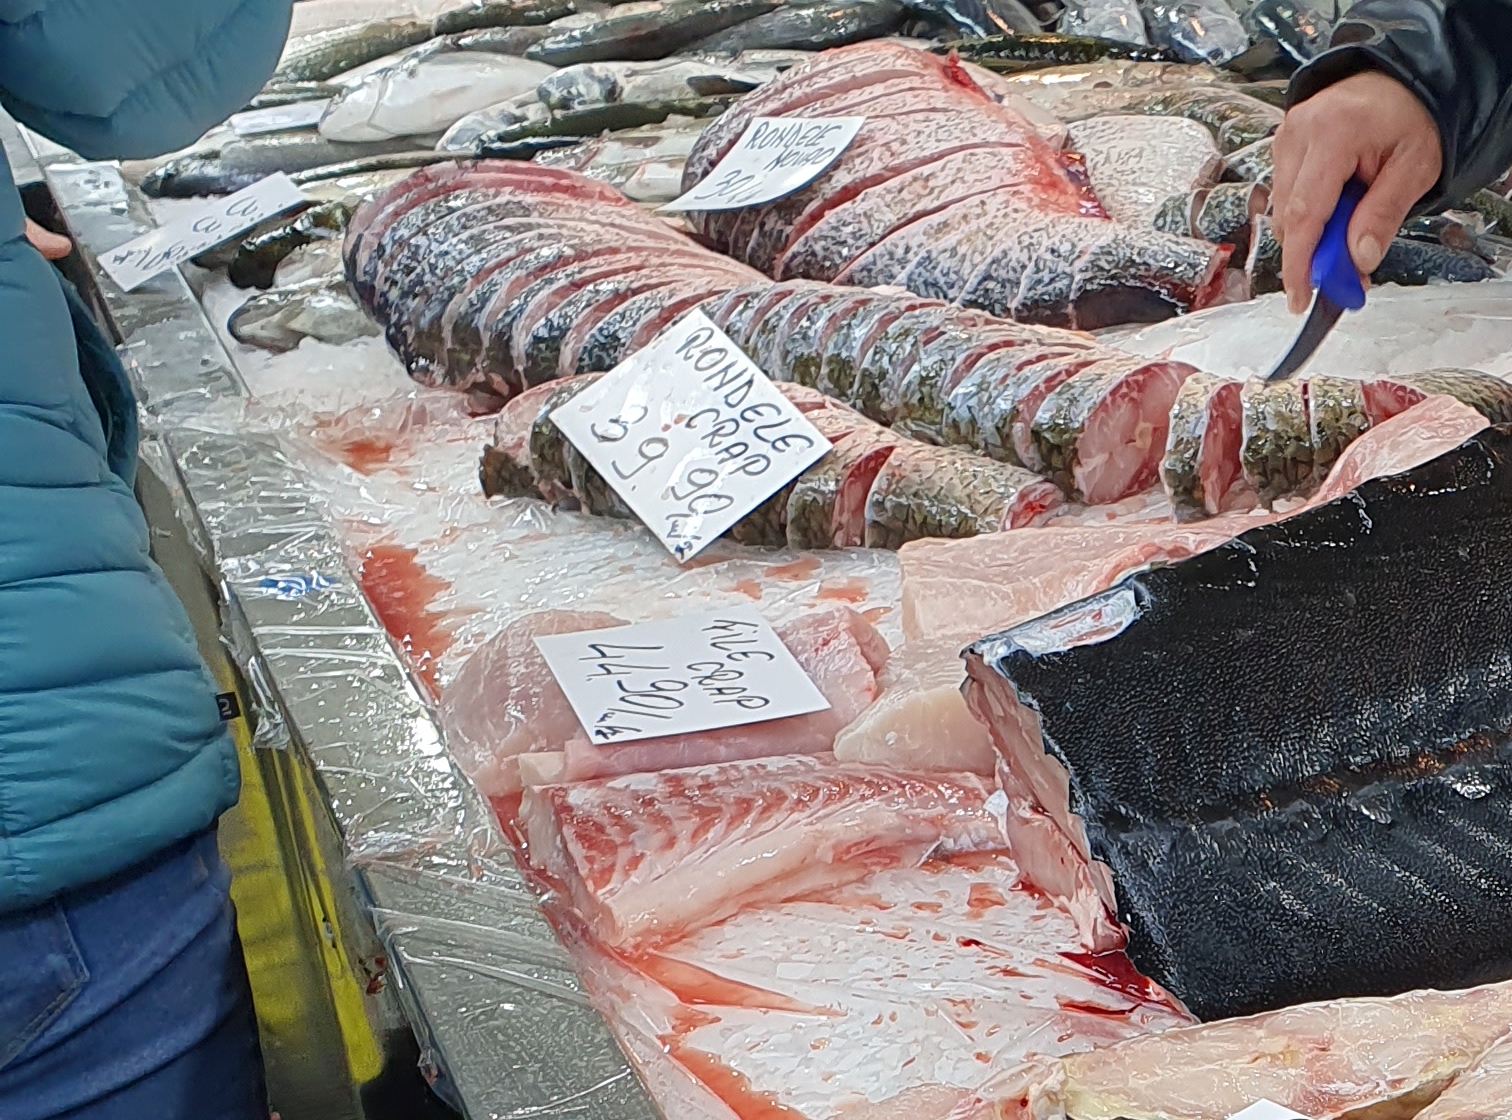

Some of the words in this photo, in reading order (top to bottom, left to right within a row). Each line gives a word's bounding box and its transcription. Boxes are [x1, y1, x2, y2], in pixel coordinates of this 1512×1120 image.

[675, 327, 814, 453] RONDELE
[685, 408, 771, 476] CRAP
[687, 661, 770, 709] CRAP
